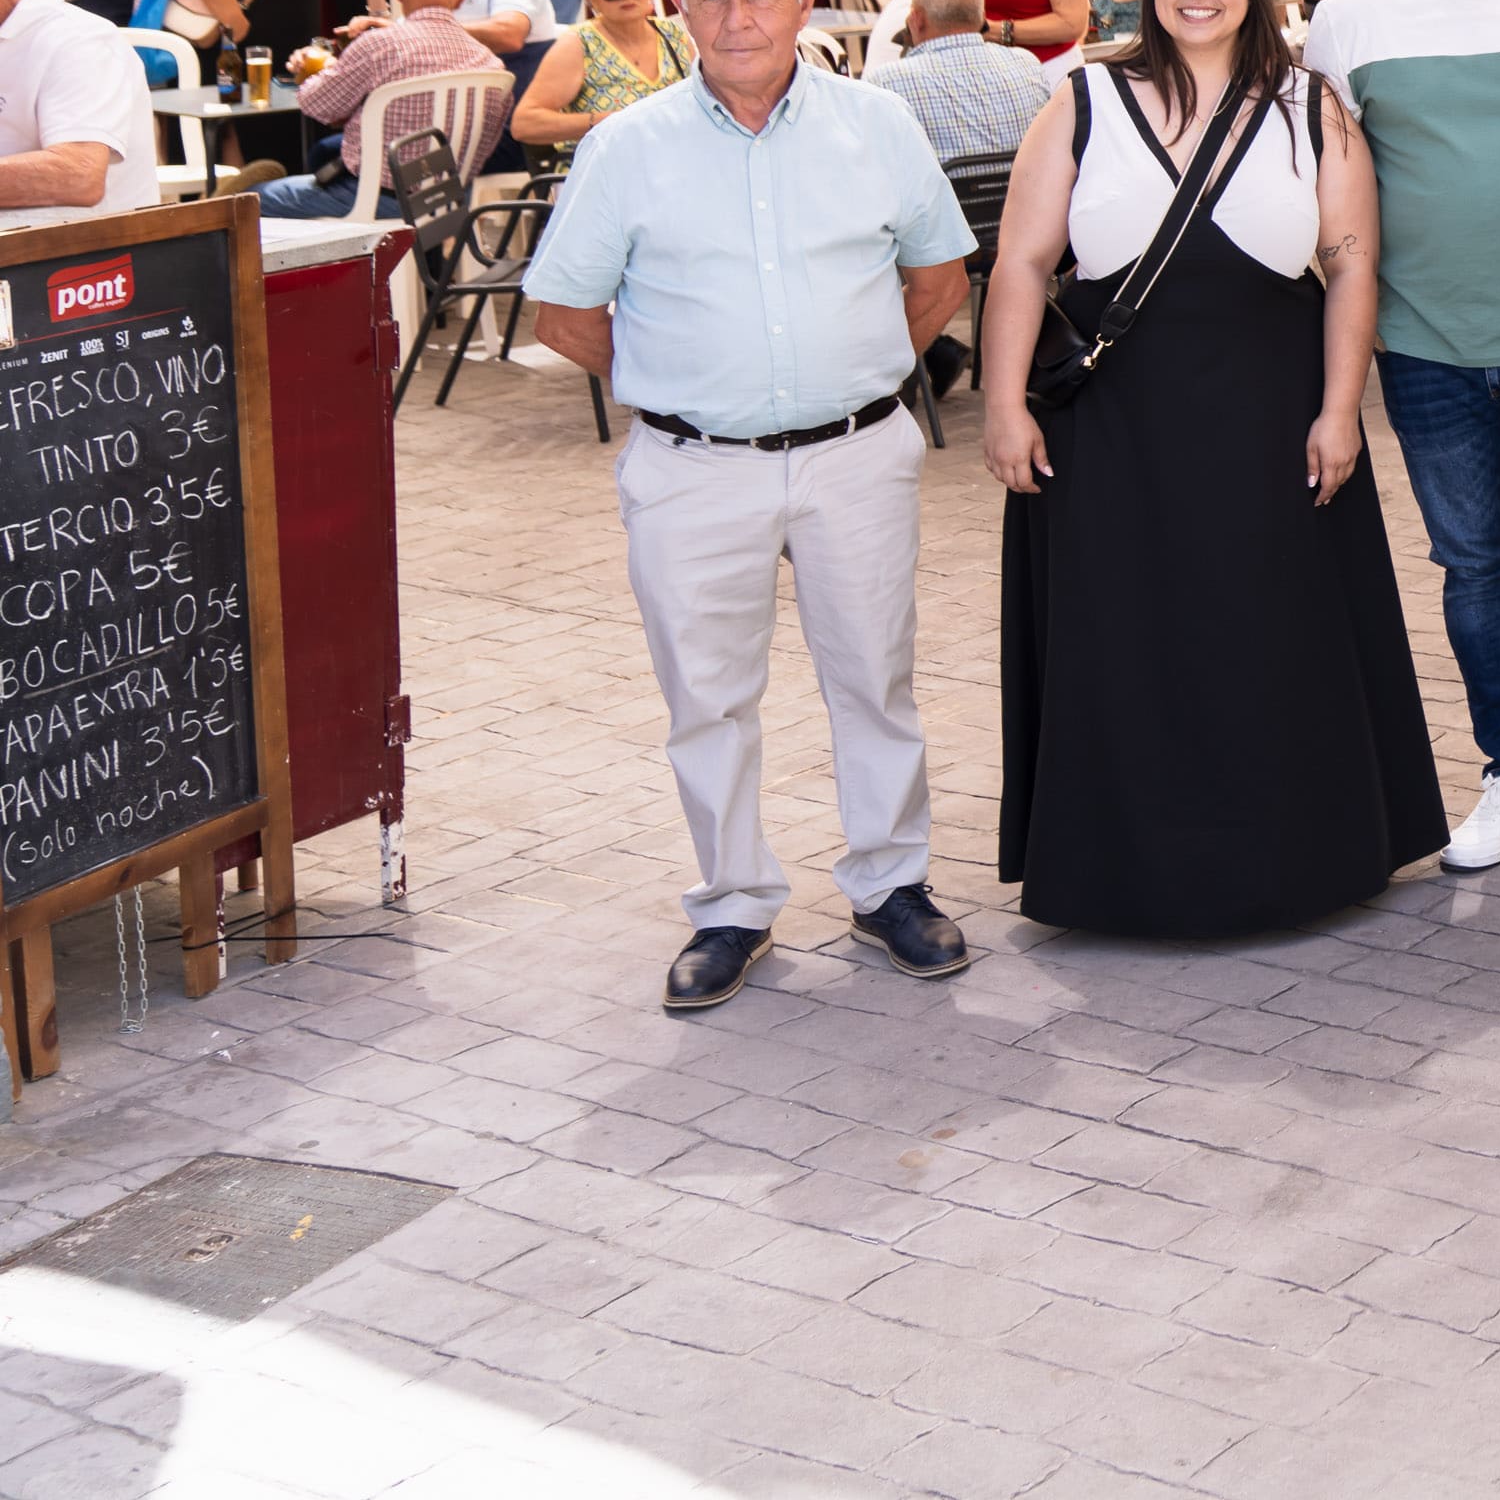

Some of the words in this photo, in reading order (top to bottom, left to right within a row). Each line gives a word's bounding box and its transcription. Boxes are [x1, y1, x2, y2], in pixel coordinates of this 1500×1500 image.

[57, 273, 127, 315] pont
[115, 329, 130, 348] SJ
[141, 326, 170, 340] ORIGINS
[155, 343, 227, 398] VINO
[26, 429, 140, 484] TINTO
[0, 497, 134, 562] TERCIO
[0, 567, 116, 626] COPA
[129, 541, 193, 590] 5€
[0, 594, 197, 700] BOCADILLO
[206, 583, 241, 628] 5€
[0, 739, 120, 826] PANINI
[3, 819, 76, 882] (solo
[96, 755, 216, 836] noche)
